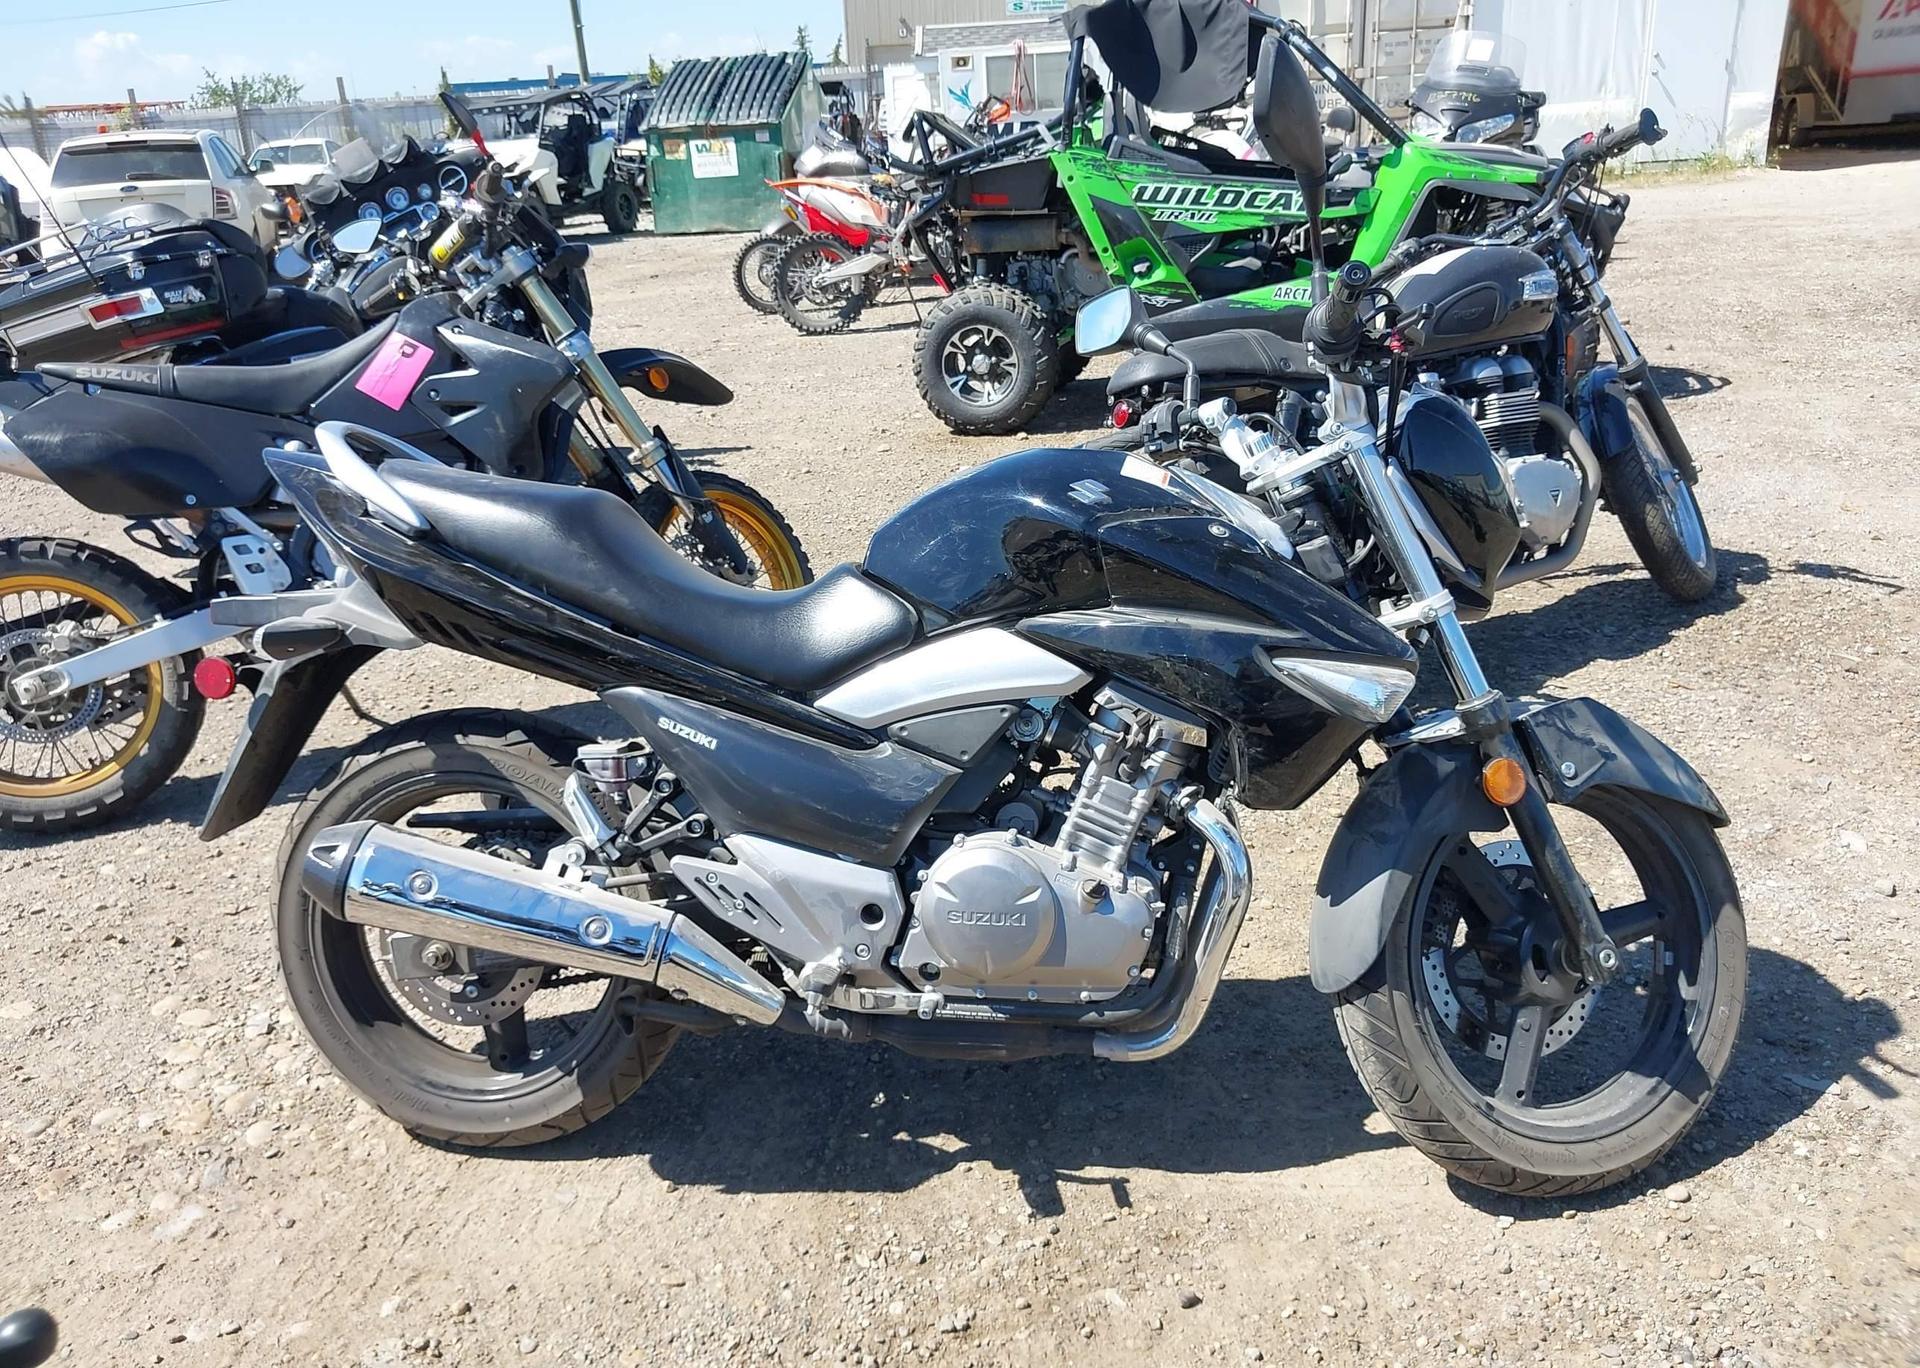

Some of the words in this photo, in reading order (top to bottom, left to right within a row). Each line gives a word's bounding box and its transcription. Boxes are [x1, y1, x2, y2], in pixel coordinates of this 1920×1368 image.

[1152, 208, 1219, 224] TRAIL
[75, 366, 158, 385] SUZUKI
[657, 716, 718, 751] SUZUKI
[946, 910, 1027, 927] SUZUKI
